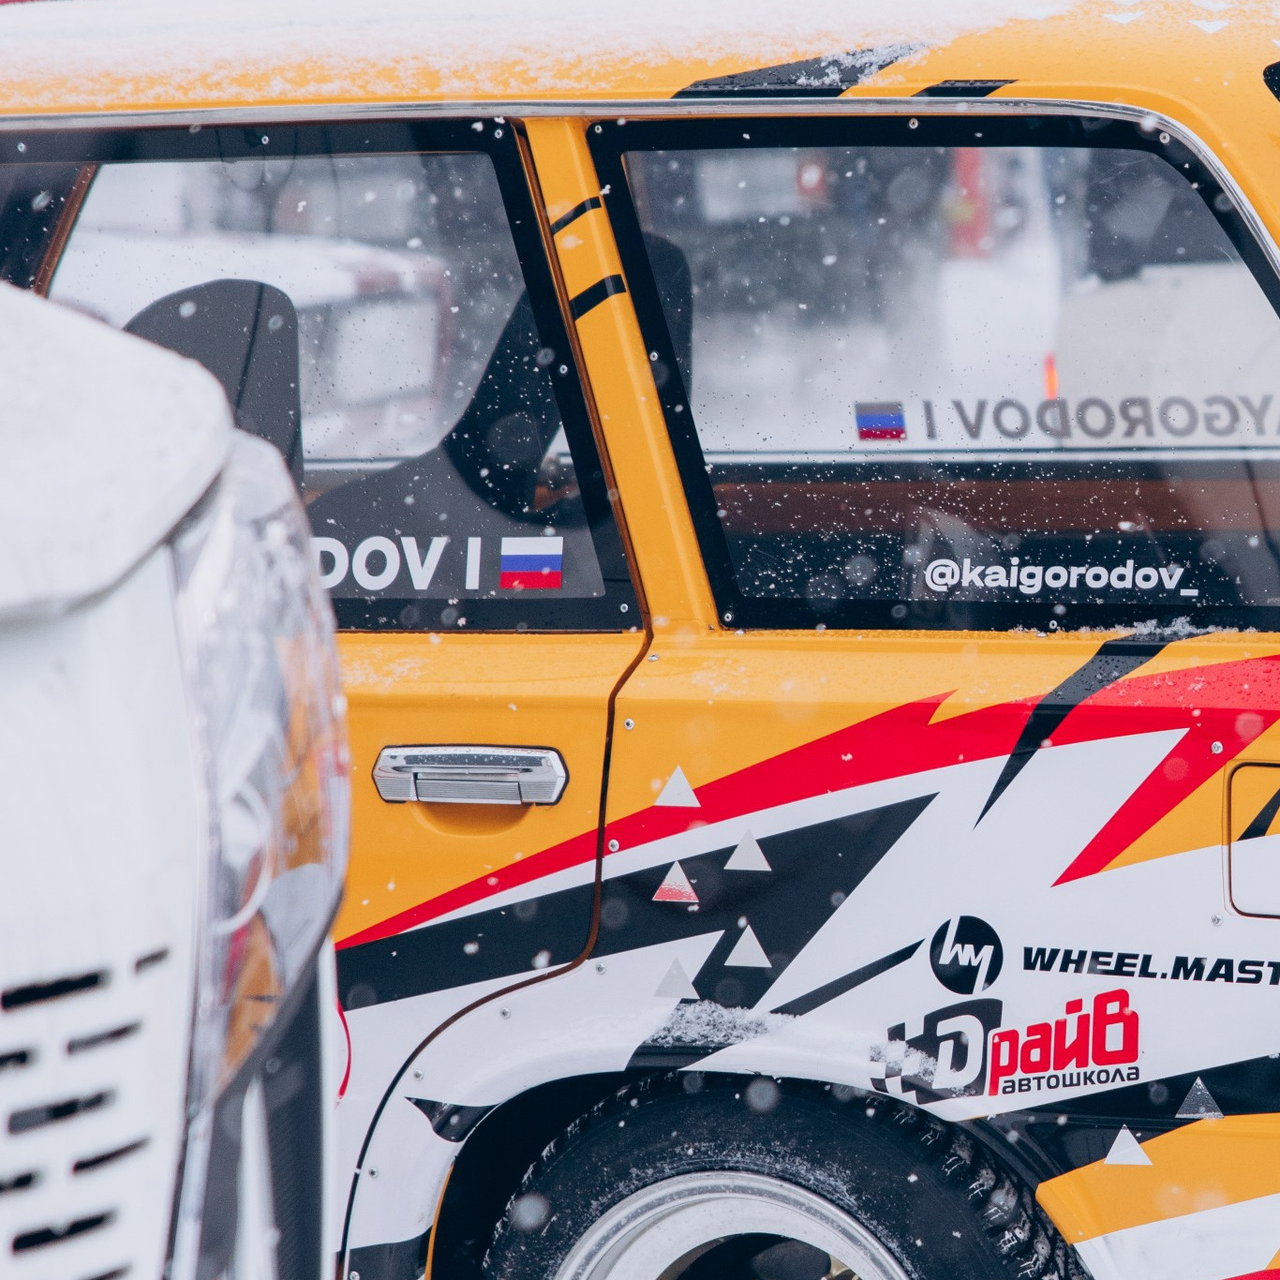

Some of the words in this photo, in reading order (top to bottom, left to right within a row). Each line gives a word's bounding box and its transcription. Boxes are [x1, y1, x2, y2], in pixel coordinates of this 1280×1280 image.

[465, 537, 482, 590] I
[925, 557, 1199, 597] @kaigorodov_
[1002, 1066, 1141, 1095] автошкола
